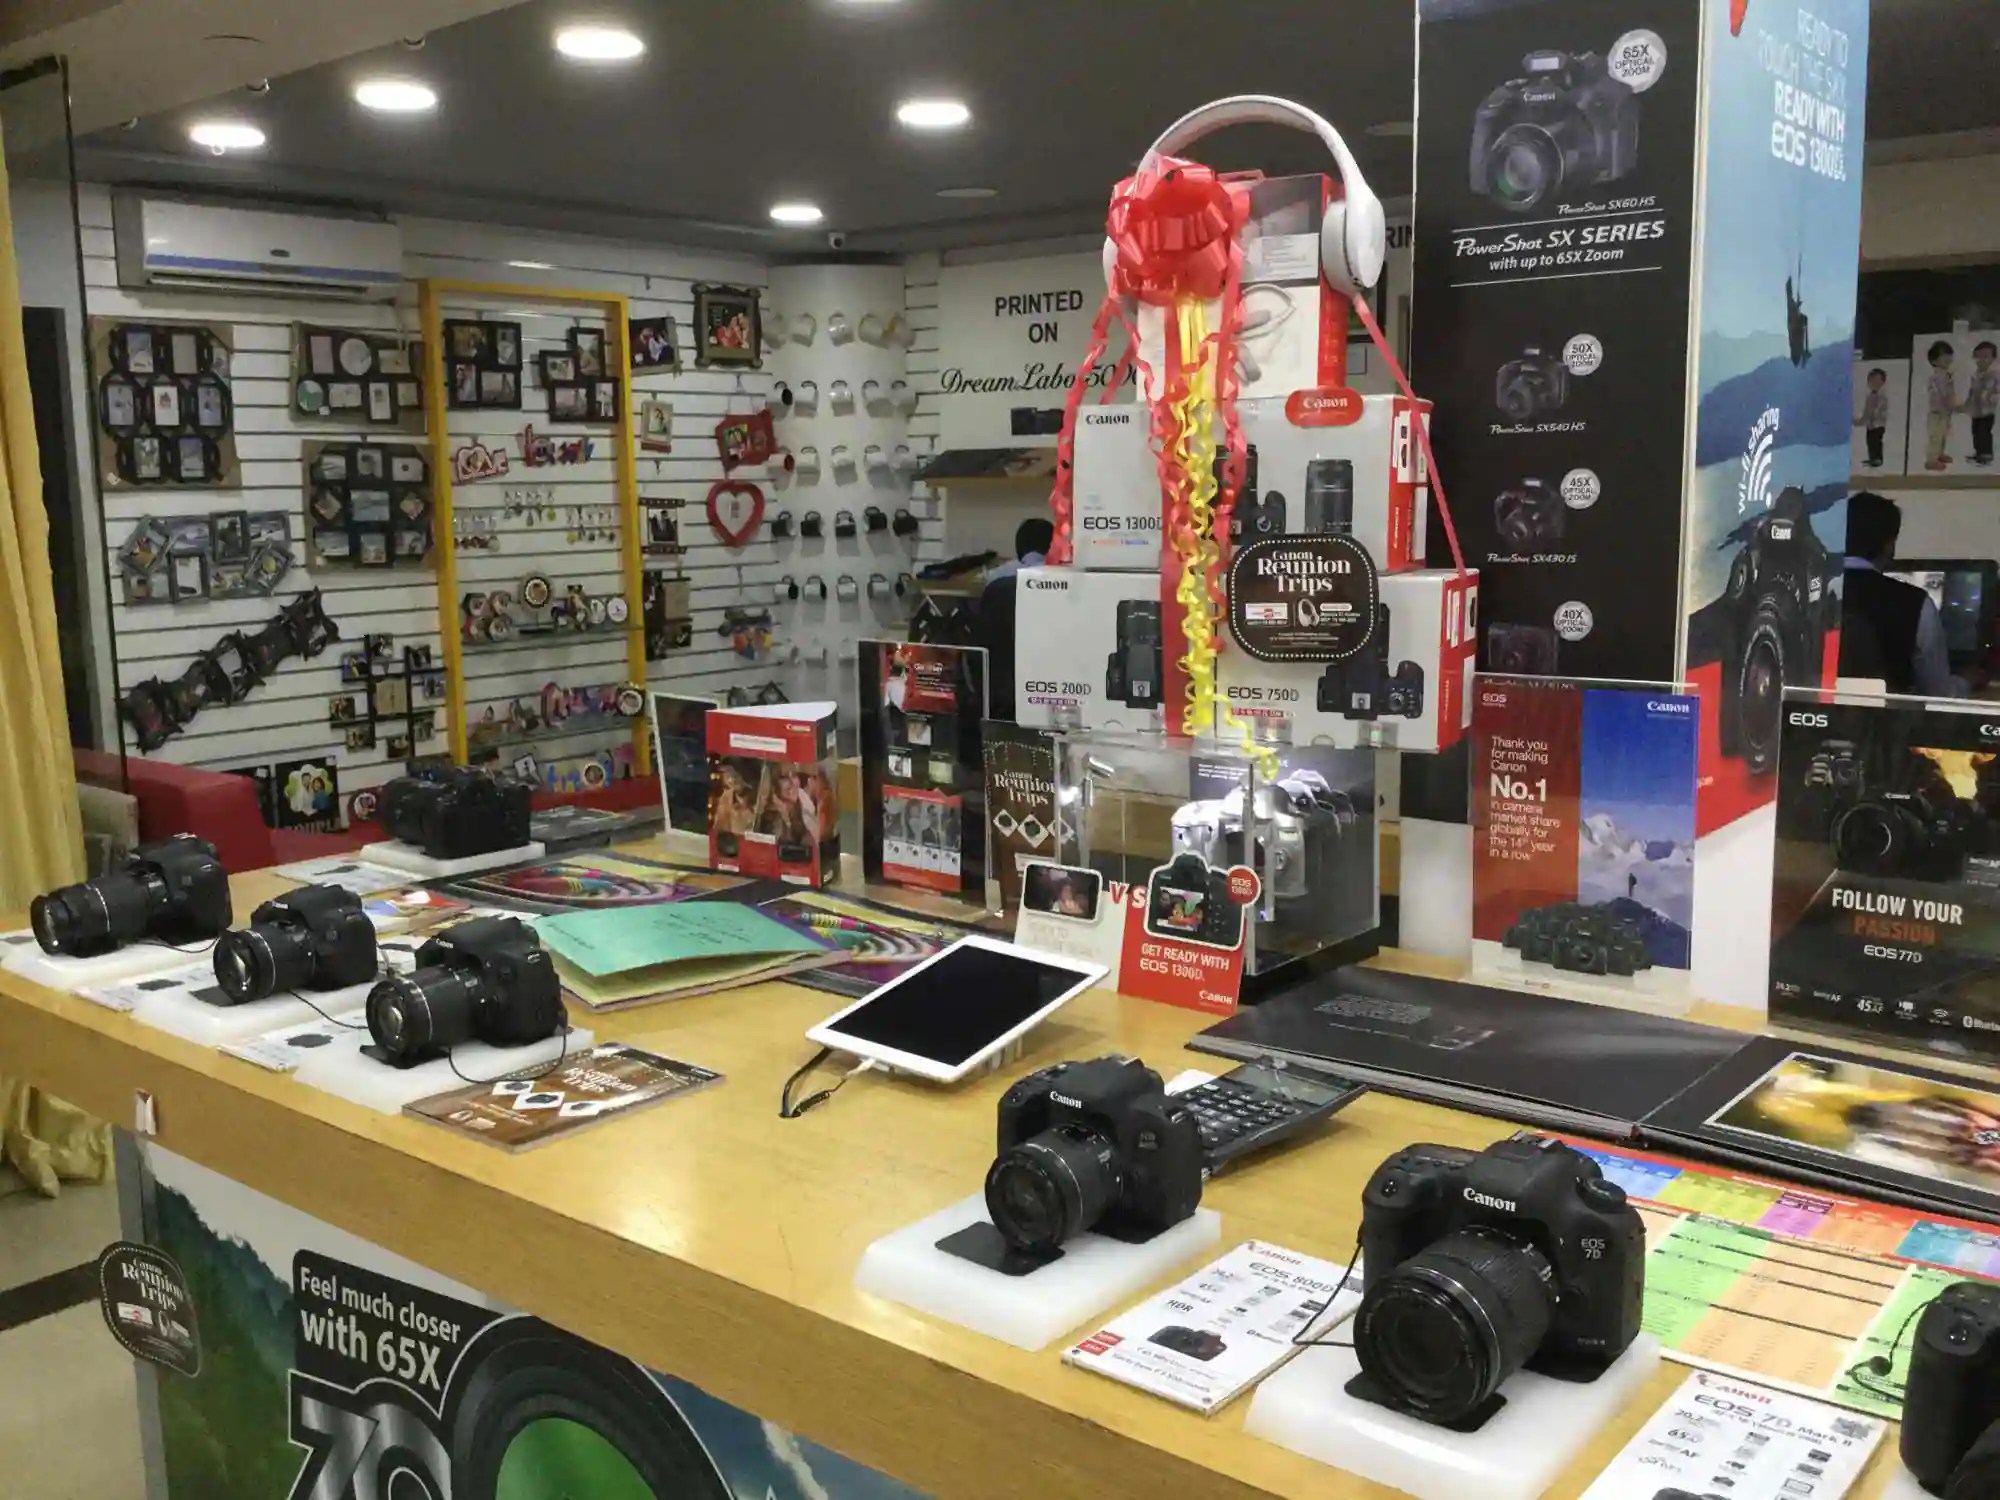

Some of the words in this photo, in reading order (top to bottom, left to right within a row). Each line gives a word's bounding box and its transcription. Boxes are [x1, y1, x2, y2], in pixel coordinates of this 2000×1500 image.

[1622, 44, 1650, 59] 65X
[1774, 81, 1815, 129] READY
[1816, 99, 1845, 142] WITH
[1771, 120, 1806, 166] EOS
[1607, 199, 1638, 210] SX60
[1638, 196, 1656, 206] HS
[1453, 233, 1542, 257] PowerShot
[1546, 229, 1576, 247] SX
[1579, 220, 1665, 245] SERIES
[1489, 257, 1517, 271] with
[1520, 258, 1537, 270] up
[1540, 254, 1553, 266] to
[1556, 251, 1582, 264] 65X
[1583, 249, 1624, 262] Zoom
[995, 290, 1083, 316] PRINTED
[1028, 322, 1058, 343] ON
[1571, 343, 1593, 354] 50X
[1303, 397, 1348, 409] Canon
[1086, 414, 1130, 425] Canon
[1083, 517, 1121, 530] EOS
[1257, 556, 1351, 576] Reunion
[1026, 579, 1068, 590] Canon
[1276, 574, 1333, 596] Trips
[1026, 681, 1057, 693] EOS
[1062, 683, 1092, 695] 200D
[1228, 686, 1262, 699] EOS
[1267, 688, 1299, 701] 750D
[1647, 701, 1690, 713] Canon
[1789, 712, 1828, 727] EOS
[1492, 736, 1525, 750] Thank
[1527, 739, 1548, 752] you
[1491, 748, 1506, 759] for
[1508, 750, 1548, 765] making
[1491, 760, 1526, 773] Canon
[1490, 773, 1547, 802] No.1
[1008, 787, 1049, 807] Trips
[1490, 823, 1530, 837] globally
[1533, 826, 1548, 838] for
[1530, 816, 1561, 828] share
[1832, 888, 1906, 916] FOLLOW
[1912, 899, 1963, 925] YOUR
[1854, 915, 1936, 945] PASSION
[1141, 943, 1162, 957] GET
[1163, 947, 1199, 964] READY
[1200, 952, 1230, 971] WITH
[1864, 944, 1897, 959] EOS
[1898, 950, 1923, 963] 77D
[1140, 958, 1169, 974] EOS
[1199, 990, 1233, 1004] Canon
[1050, 1090, 1082, 1109] Canon
[1463, 1187, 1516, 1212] Canon
[1581, 1238, 1605, 1249] EOS
[1584, 1248, 1601, 1259] 7D
[1249, 1262, 1289, 1279] EOS
[301, 1266, 337, 1301] Feel
[342, 1286, 394, 1321] much
[400, 1301, 460, 1344] closer
[301, 1307, 367, 1363] with
[376, 1330, 441, 1391] 65X
[1694, 1394, 1755, 1417] EOS
[1761, 1413, 1792, 1429] 7D
